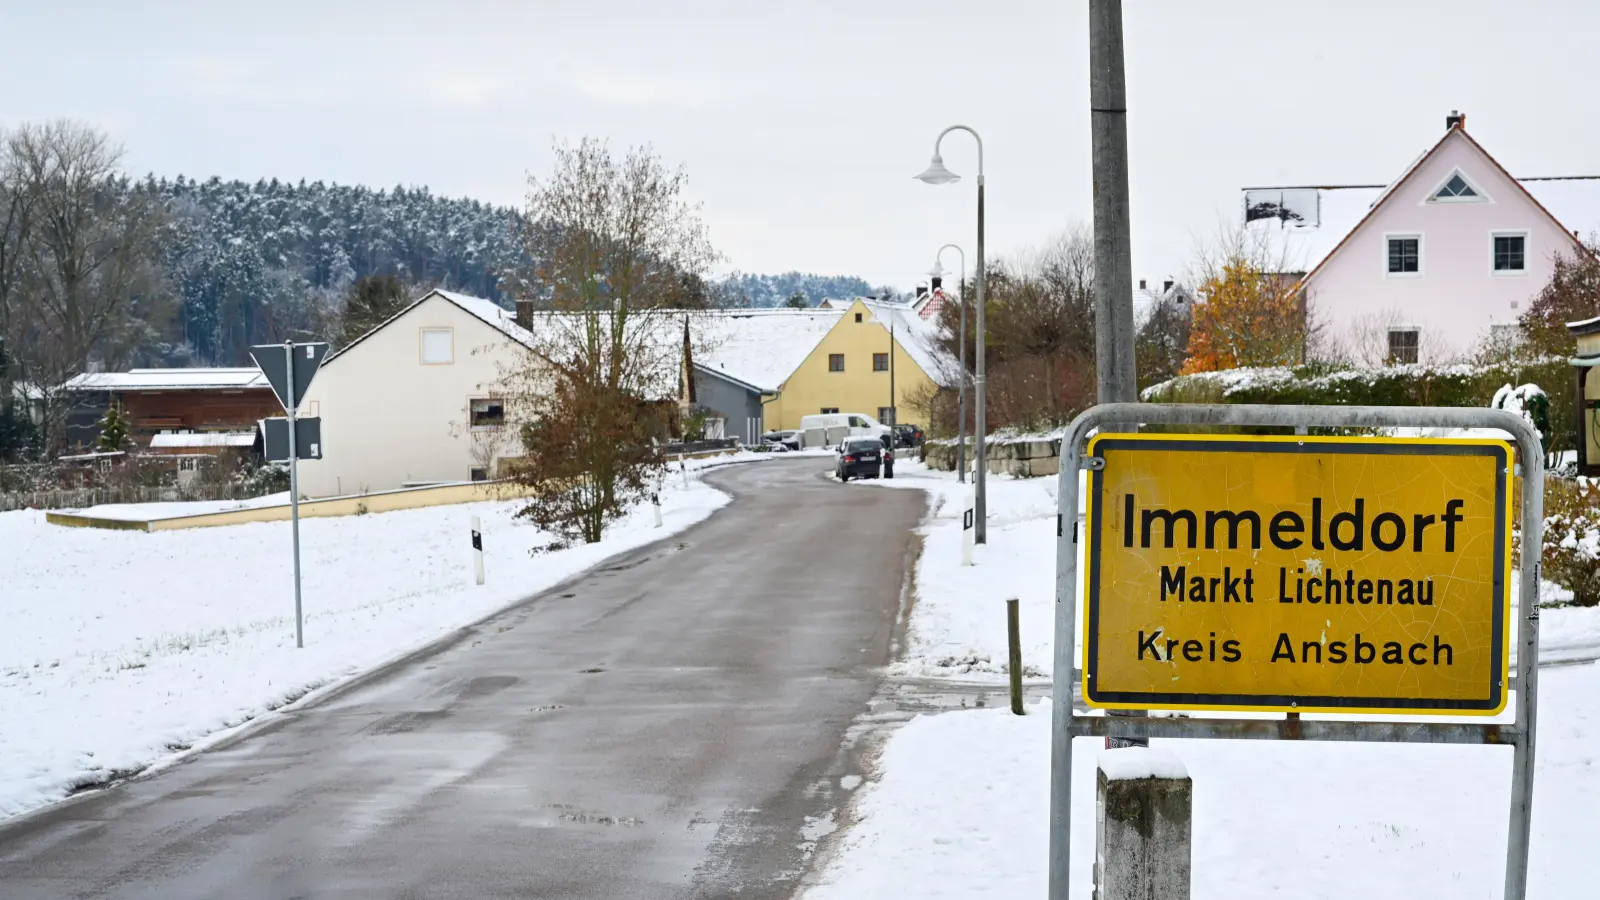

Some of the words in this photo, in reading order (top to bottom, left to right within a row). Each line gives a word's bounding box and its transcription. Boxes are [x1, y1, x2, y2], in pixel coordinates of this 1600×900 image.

[1123, 493, 1464, 553] Immeldorf
[1160, 565, 1254, 603] Markt
[1279, 566, 1434, 606] Lichtenau
[1137, 630, 1242, 663] Kreis
[1270, 632, 1453, 666] Ansbach
